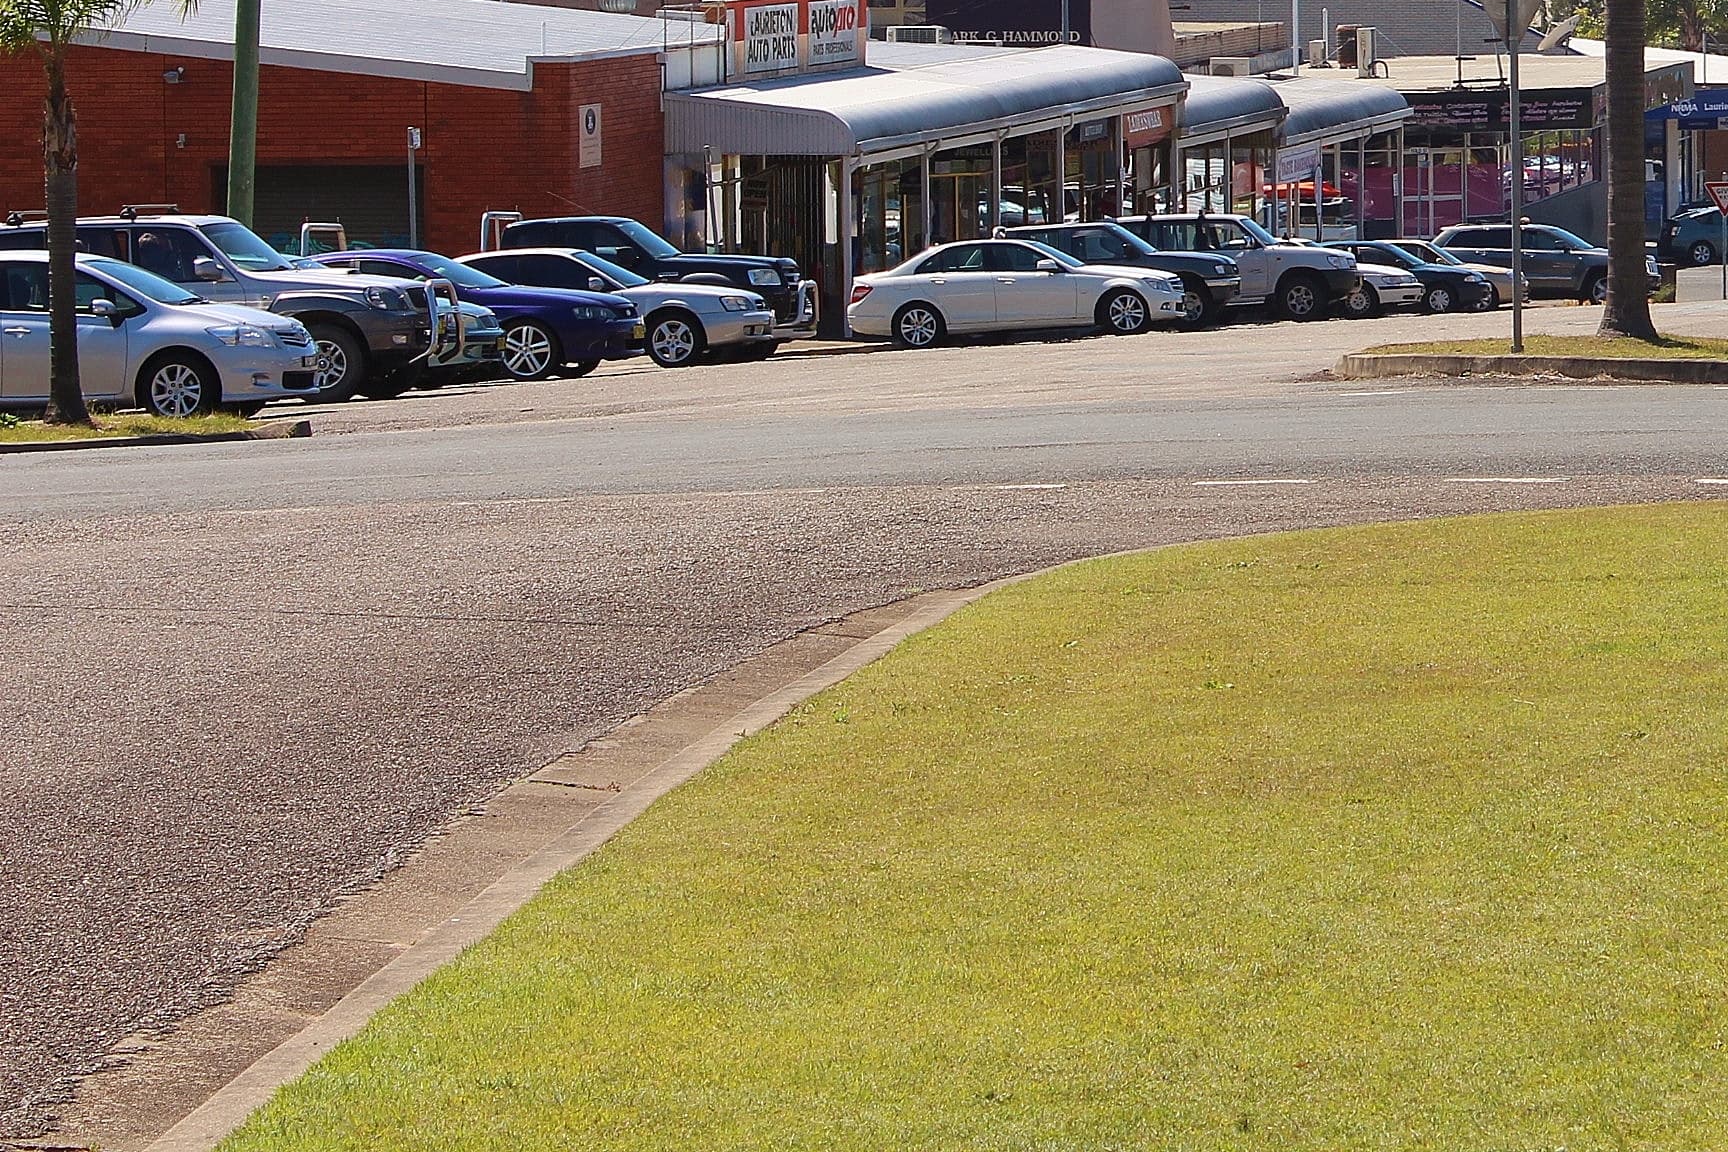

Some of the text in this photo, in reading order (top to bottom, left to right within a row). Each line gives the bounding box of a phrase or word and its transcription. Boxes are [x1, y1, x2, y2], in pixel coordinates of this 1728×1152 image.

[951, 31, 978, 41] ARK
[985, 31, 997, 41] G
[748, 36, 795, 63] AUTO PARTS
[1671, 104, 1698, 113] NRMA
